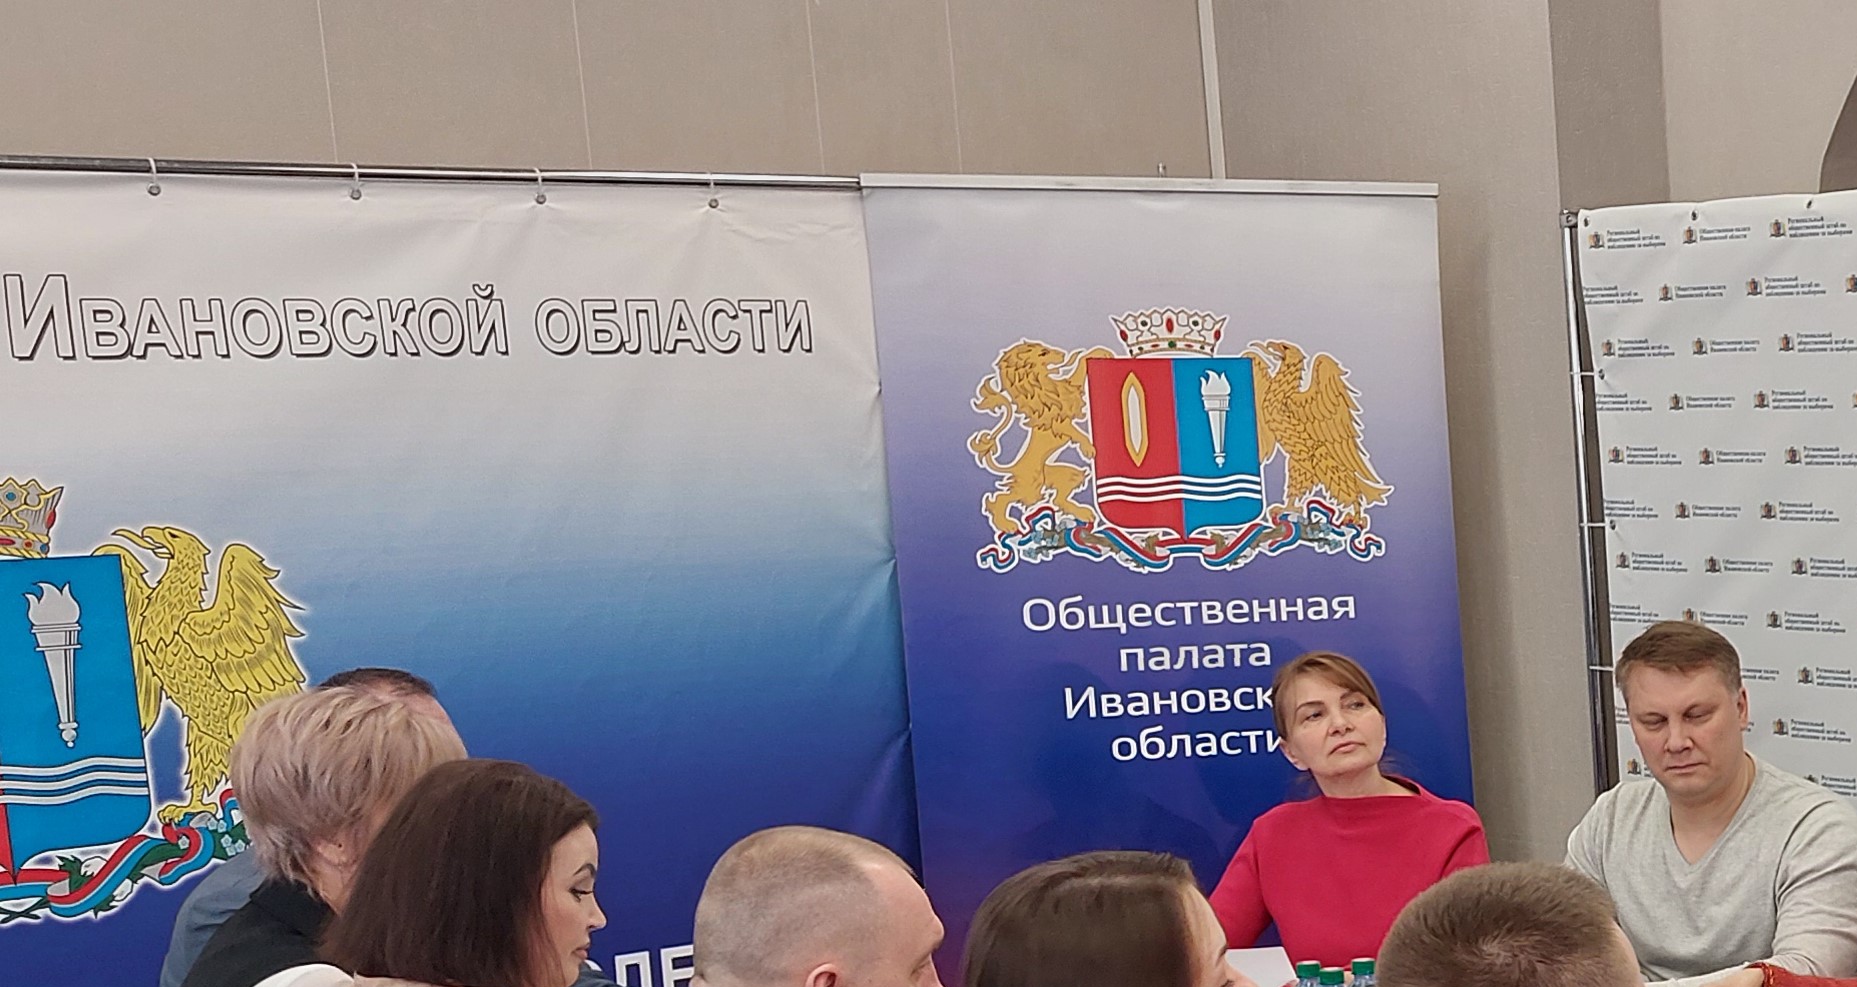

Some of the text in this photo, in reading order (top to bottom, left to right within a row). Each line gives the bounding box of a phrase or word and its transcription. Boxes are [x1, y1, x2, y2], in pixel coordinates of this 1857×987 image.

[1022, 595, 1356, 634] Общественная
[1119, 641, 1272, 672] палата
[1064, 686, 1274, 720] Ивановск
